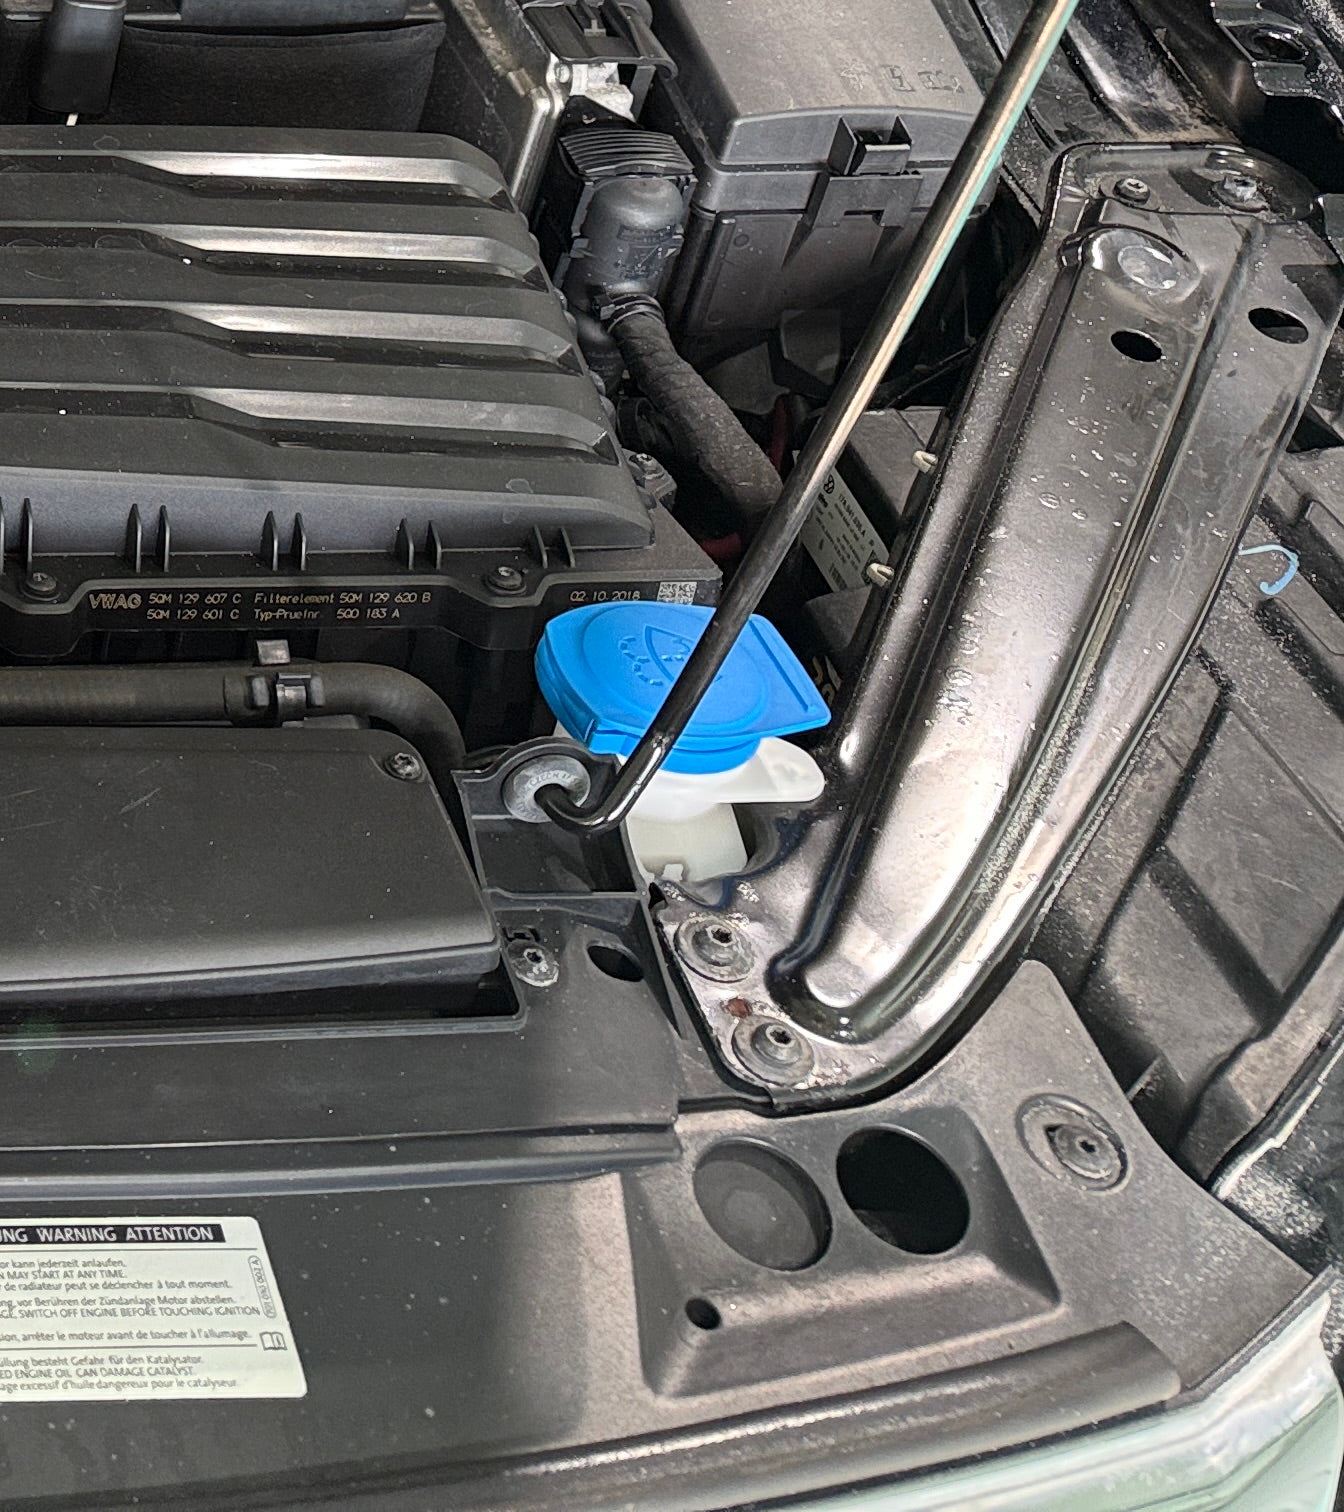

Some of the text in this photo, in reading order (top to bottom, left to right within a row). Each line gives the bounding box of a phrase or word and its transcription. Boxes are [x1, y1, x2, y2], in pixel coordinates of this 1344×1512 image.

[88, 593, 242, 610] VWAG 5QM 129 607 C
[254, 592, 432, 604] Filterelement 5QM 129 620 B
[146, 608, 240, 620] 5QM 129 601 C
[365, 608, 387, 619] 183
[391, 608, 401, 619] A
[36, 1226, 117, 1242] WARNING
[125, 1226, 215, 1242] ATTENTION
[11, 1260, 35, 1269] kann
[37, 1258, 79, 1272] jederzeit
[81, 1258, 128, 1268] anlaufen.
[7, 1271, 29, 1280] MAY
[32, 1270, 60, 1280] START
[63, 1269, 75, 1279] AT
[77, 1269, 97, 1278] ANY
[100, 1269, 128, 1279] TIME.
[4, 1283, 17, 1292] de
[18, 1282, 63, 1291] radiateur
[64, 1281, 88, 1294] peut
[101, 1280, 154, 1289] déclencher
[157, 1280, 164, 1289] à
[165, 1280, 187, 1289] tout
[188, 1280, 233, 1289] moment.
[16, 1299, 33, 1308] vor
[34, 1297, 79, 1307] Berühren
[80, 1297, 97, 1306] der
[99, 1296, 156, 1309] Zündanlage
[157, 1296, 188, 1305] Motor
[190, 1296, 237, 1305] abstellen.
[19, 1309, 58, 1319] SWITCH
[59, 1308, 79, 1318] OFF
[80, 1307, 117, 1318] ENGINE
[119, 1307, 157, 1317] BEFORE
[159, 1306, 212, 1316] TOUCHING
[214, 1306, 261, 1316] IGNITION
[30, 1356, 68, 1367] besteht
[70, 1356, 105, 1366] Gefahr
[107, 1356, 124, 1365] für
[125, 1355, 144, 1365] den
[146, 1354, 204, 1367] Katalysator.
[14, 1370, 53, 1380] ENGINE
[54, 1369, 72, 1379] OIL
[75, 1368, 98, 1378] CAN
[99, 1367, 145, 1377] DAMAGE
[146, 1366, 197, 1376] CATALYST.
